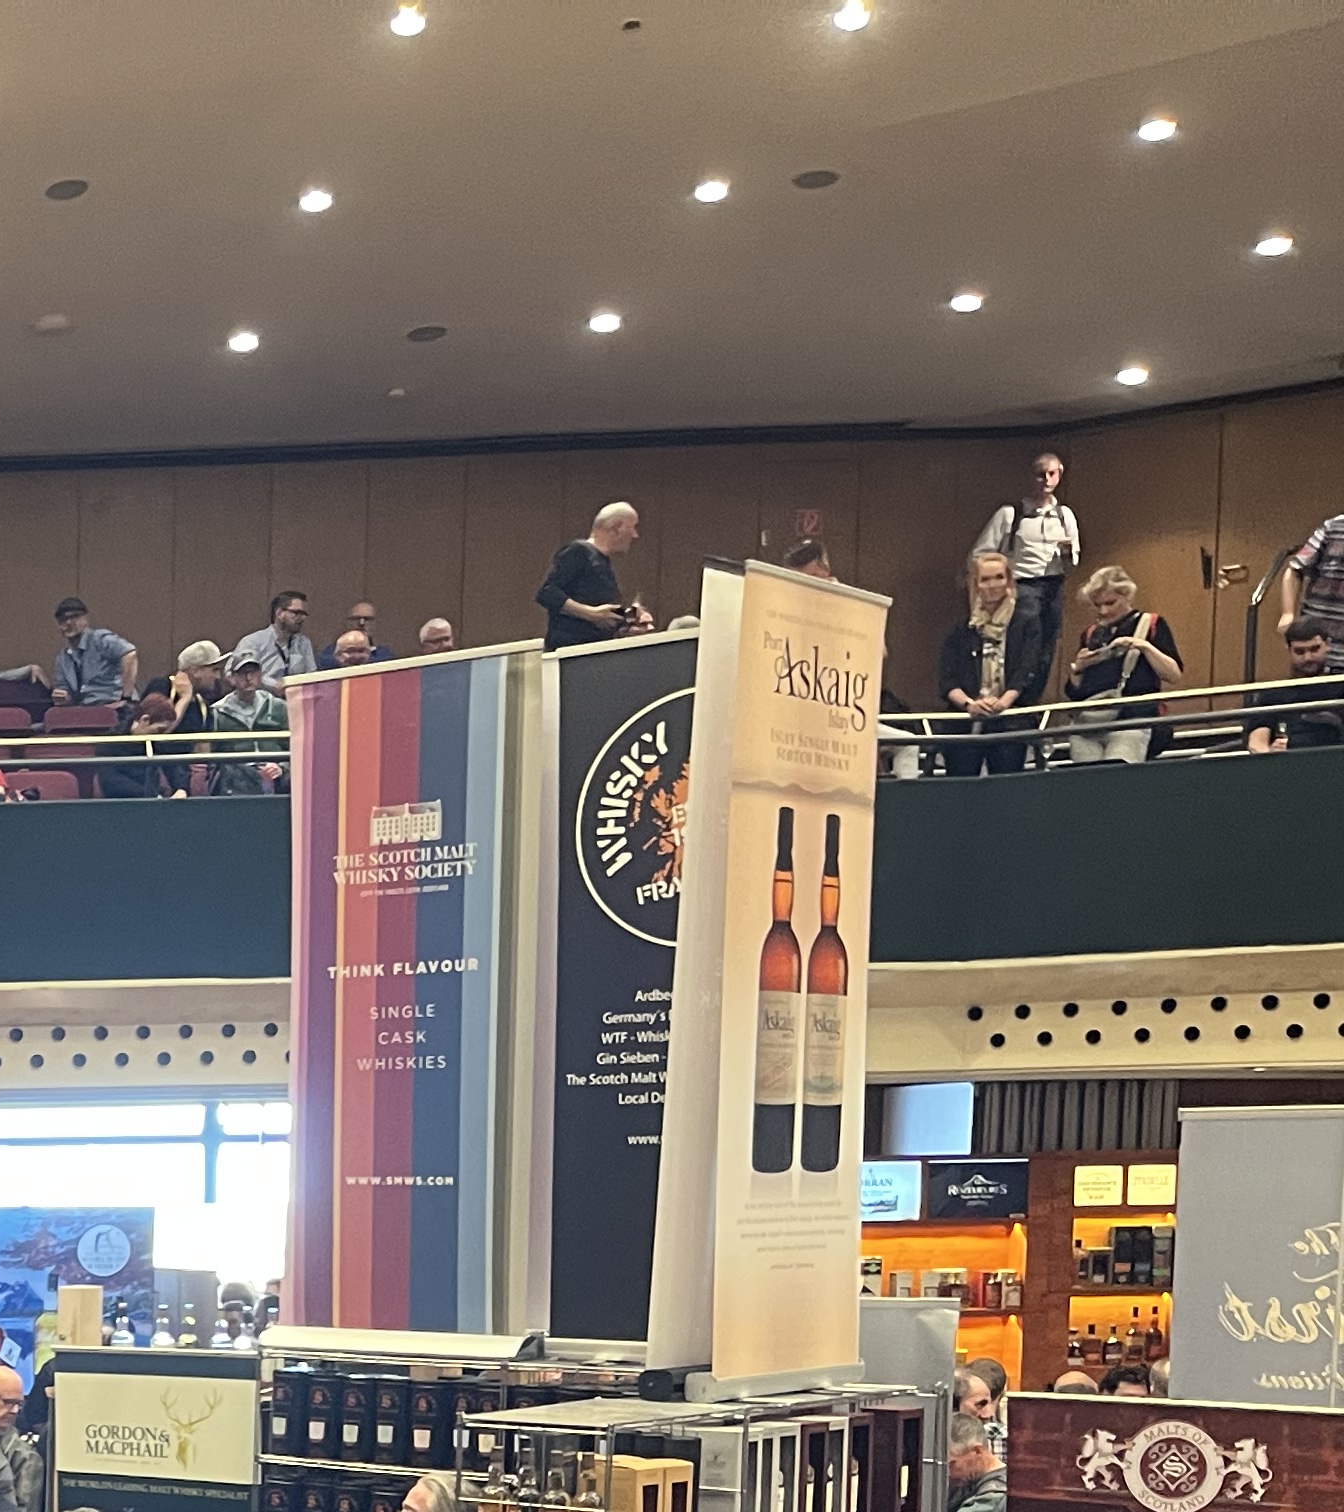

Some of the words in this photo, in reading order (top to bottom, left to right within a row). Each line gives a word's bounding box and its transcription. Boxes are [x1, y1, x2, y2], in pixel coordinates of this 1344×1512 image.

[774, 637, 869, 732] Askaig
[596, 720, 668, 878] WHISKY
[333, 853, 364, 869] THE
[368, 847, 431, 866] SCOTCH
[434, 842, 478, 860] MALT
[332, 866, 402, 886] WHISKY
[404, 859, 478, 881] SOCIETY
[327, 964, 385, 979] THINK
[393, 958, 479, 975] FLAVOUR
[370, 1003, 436, 1019] SINGLE
[378, 1030, 427, 1045] CASK
[601, 1032, 628, 1044] WTF
[356, 1055, 447, 1070] WHISKIES
[596, 1053, 618, 1065] Gin
[620, 1052, 659, 1065] Sieben
[566, 1074, 587, 1086] The
[589, 1072, 628, 1086] Scotch
[631, 1071, 656, 1085] Malt
[618, 1092, 648, 1105] Local
[345, 1176, 454, 1186] WWW.SMWS.COM
[1144, 1425, 1189, 1443] MALTS
[1192, 1432, 1210, 1445] OF
[85, 1439, 169, 1459] MACPHAIL
[1138, 1490, 1205, 1512] SCOTLAND
